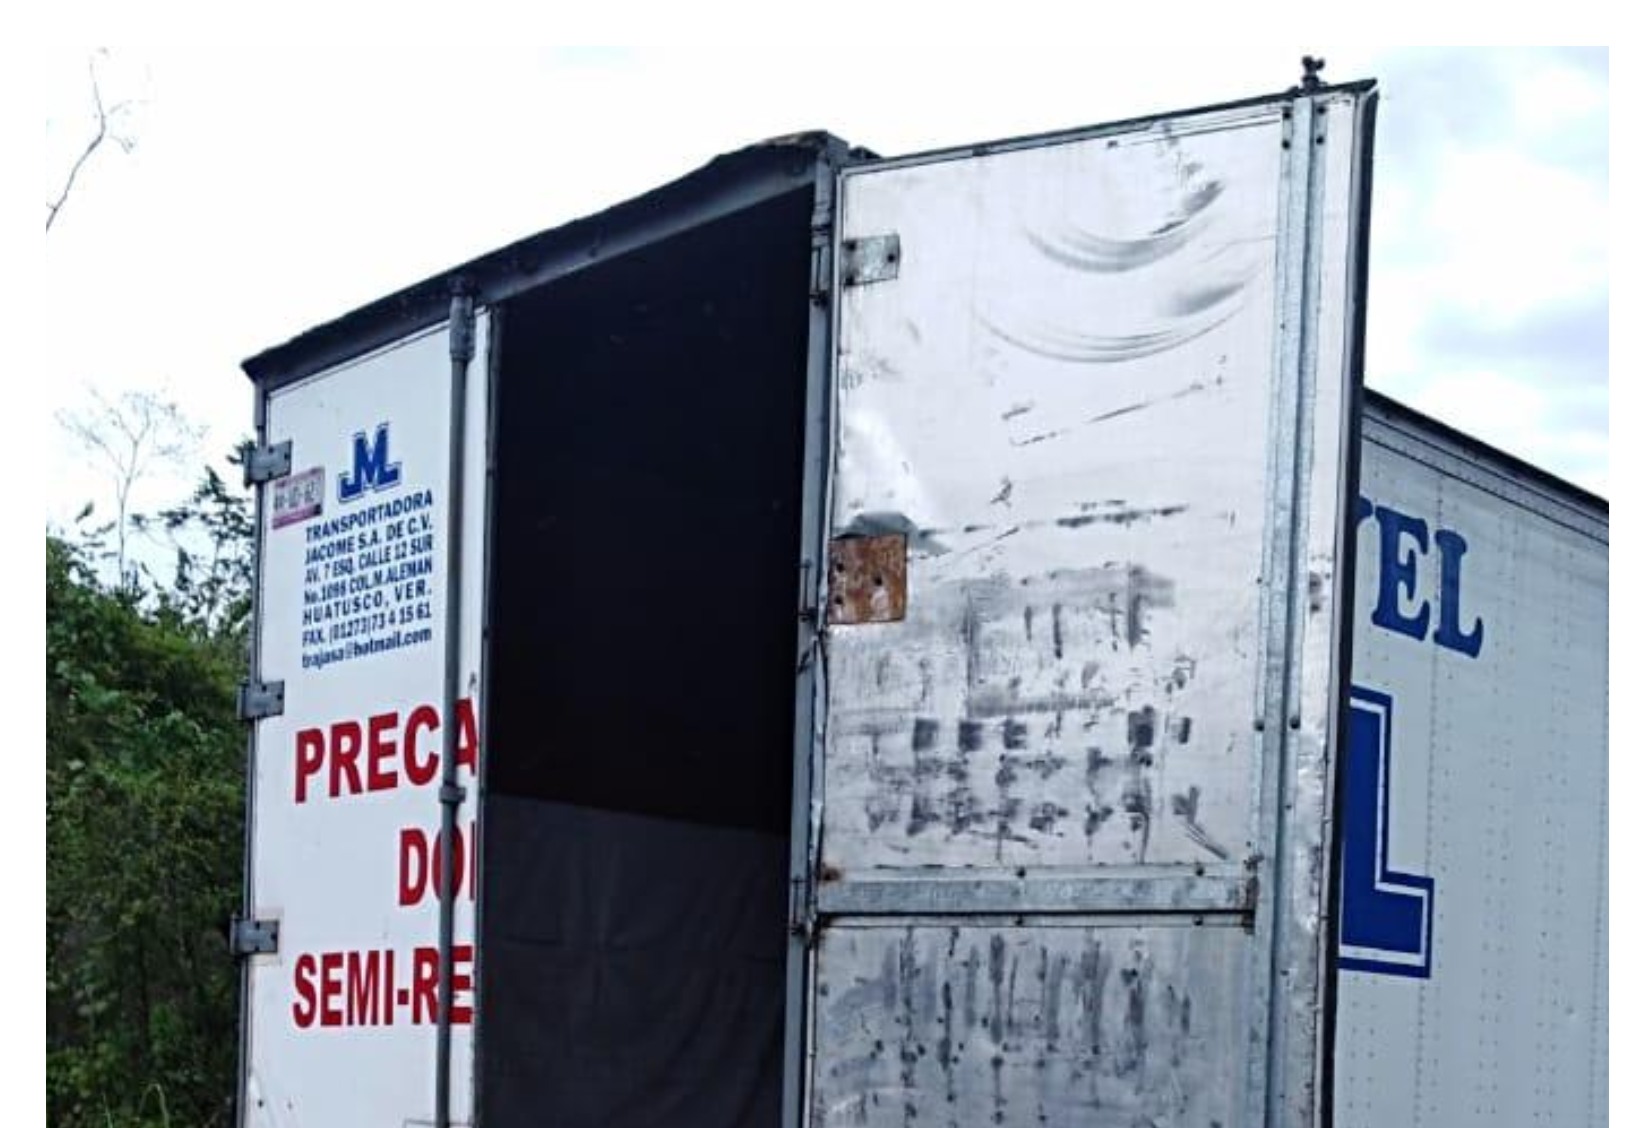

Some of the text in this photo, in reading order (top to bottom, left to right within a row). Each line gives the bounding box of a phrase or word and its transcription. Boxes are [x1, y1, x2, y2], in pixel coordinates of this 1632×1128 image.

[305, 536, 355, 564] JACOME
[387, 521, 404, 540] DE
[408, 513, 433, 534] C.V.
[306, 489, 433, 542] TRANSPORTADORA
[358, 546, 391, 570] CALLE
[395, 542, 407, 560] 12
[410, 534, 433, 555] SUR
[394, 579, 432, 602] VER.
[399, 606, 414, 625] 15
[416, 602, 432, 621] 61
[399, 820, 476, 906] DO
[293, 945, 474, 1028] SEMI-RE
